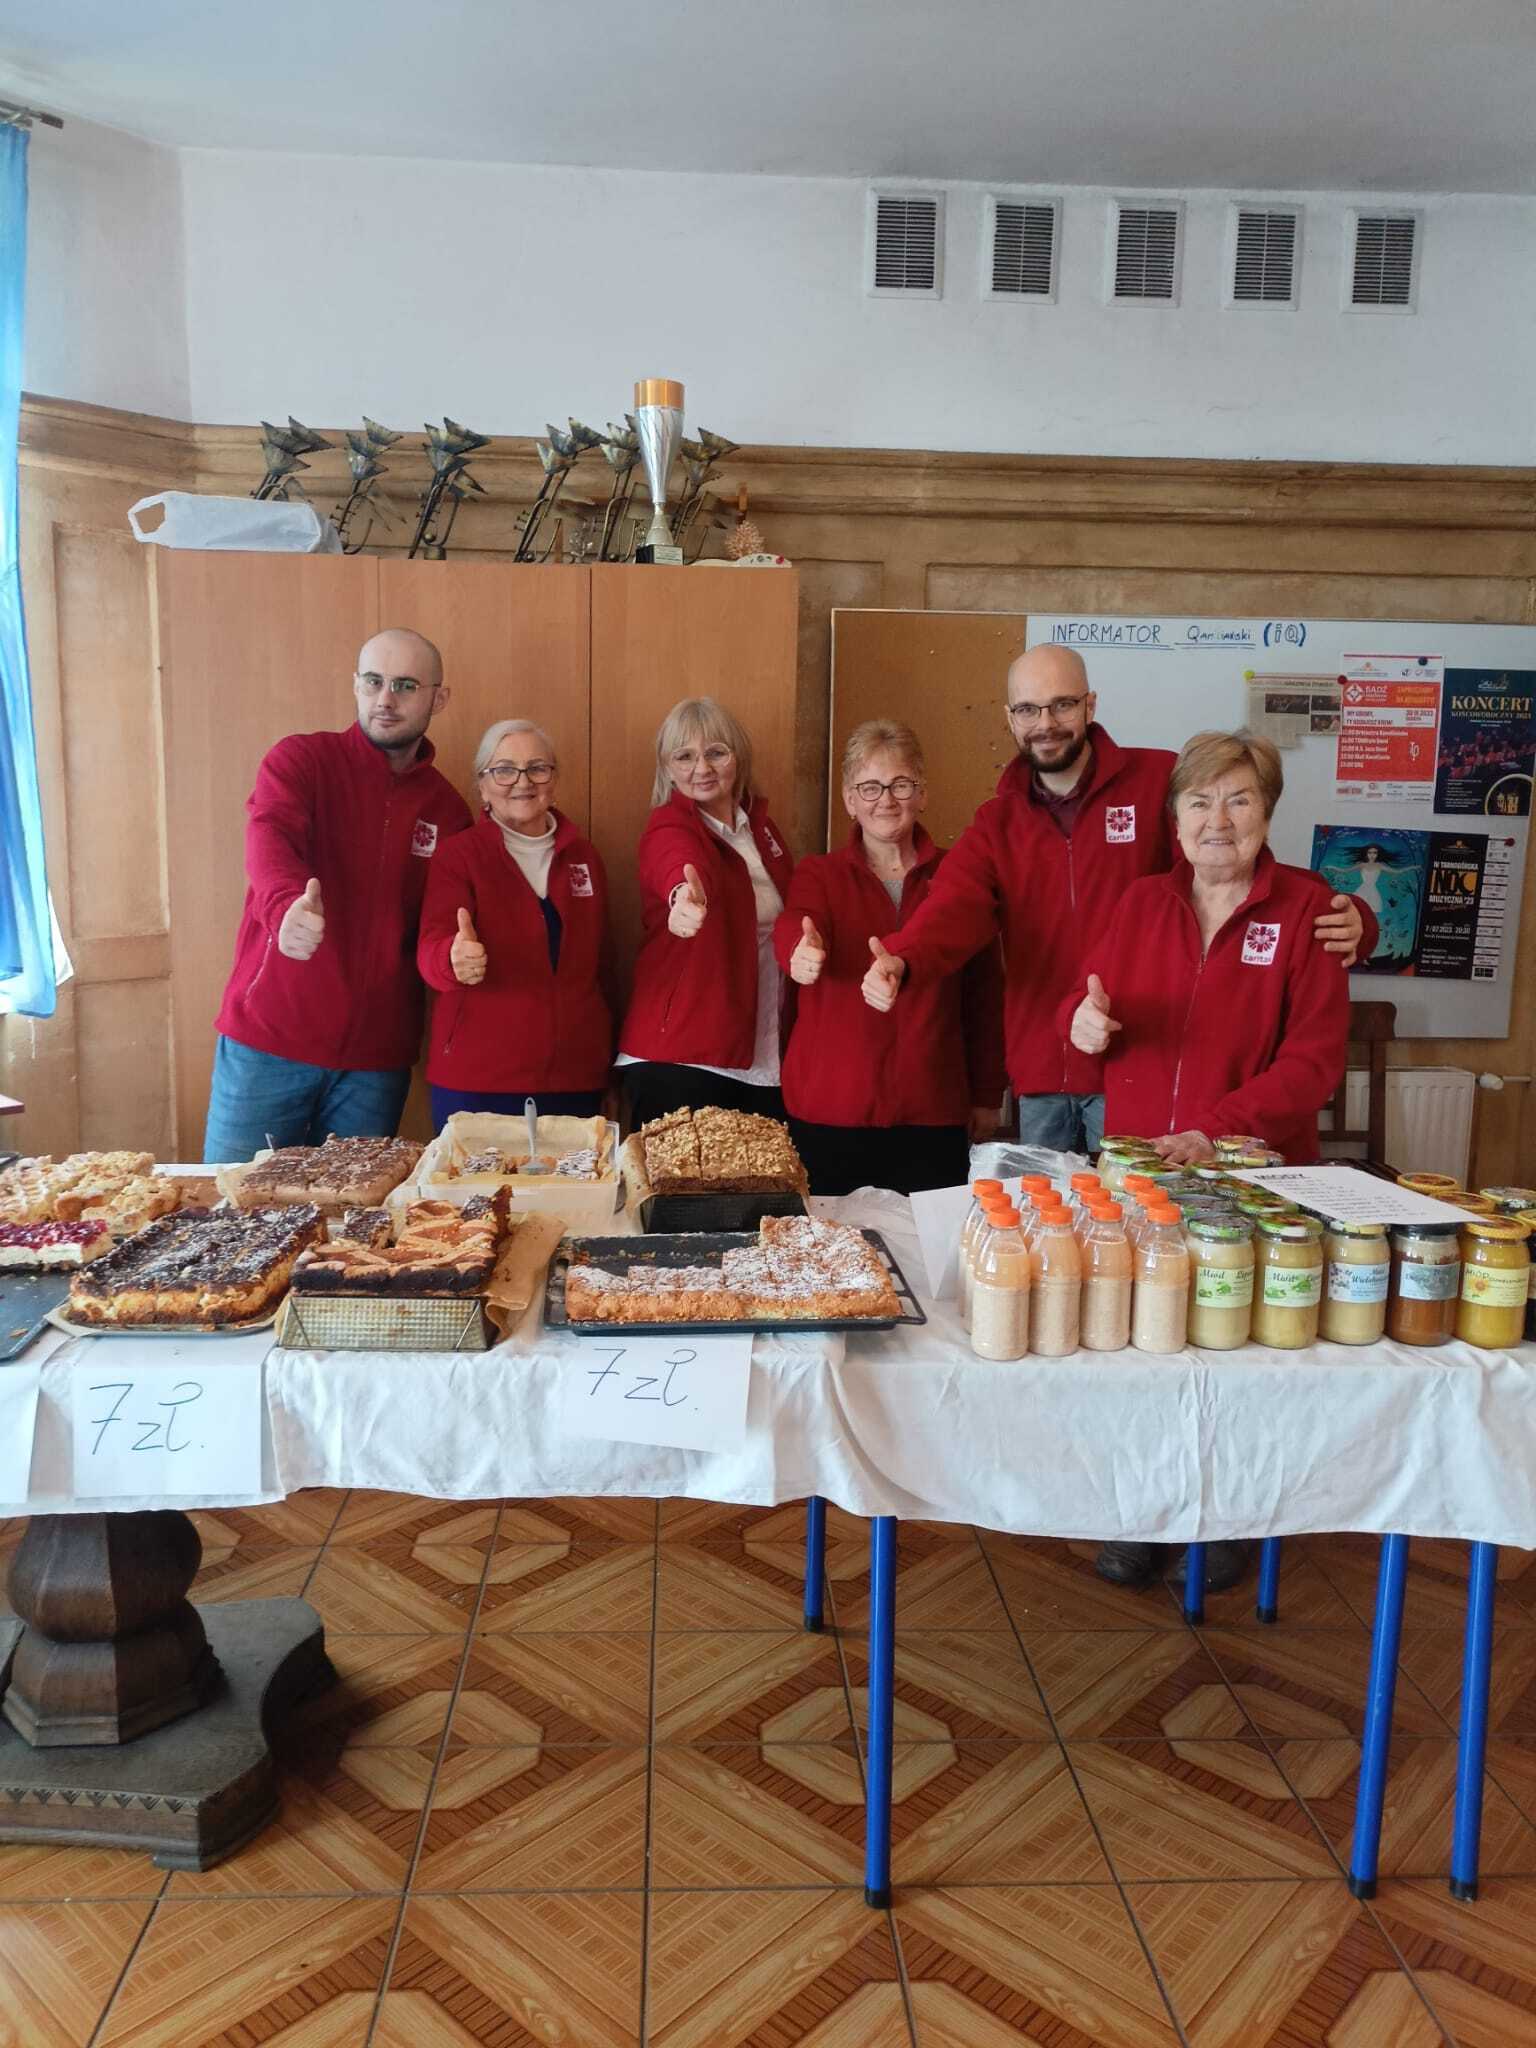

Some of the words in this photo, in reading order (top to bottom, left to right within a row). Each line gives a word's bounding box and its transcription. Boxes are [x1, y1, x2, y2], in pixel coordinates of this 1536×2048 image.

[1051, 623, 1161, 642] INFORMATOR
[1451, 695, 1534, 711] KONCERT
[1430, 869, 1478, 896] NOC
[588, 1348, 627, 1396] 7
[89, 1383, 134, 1456] 7
